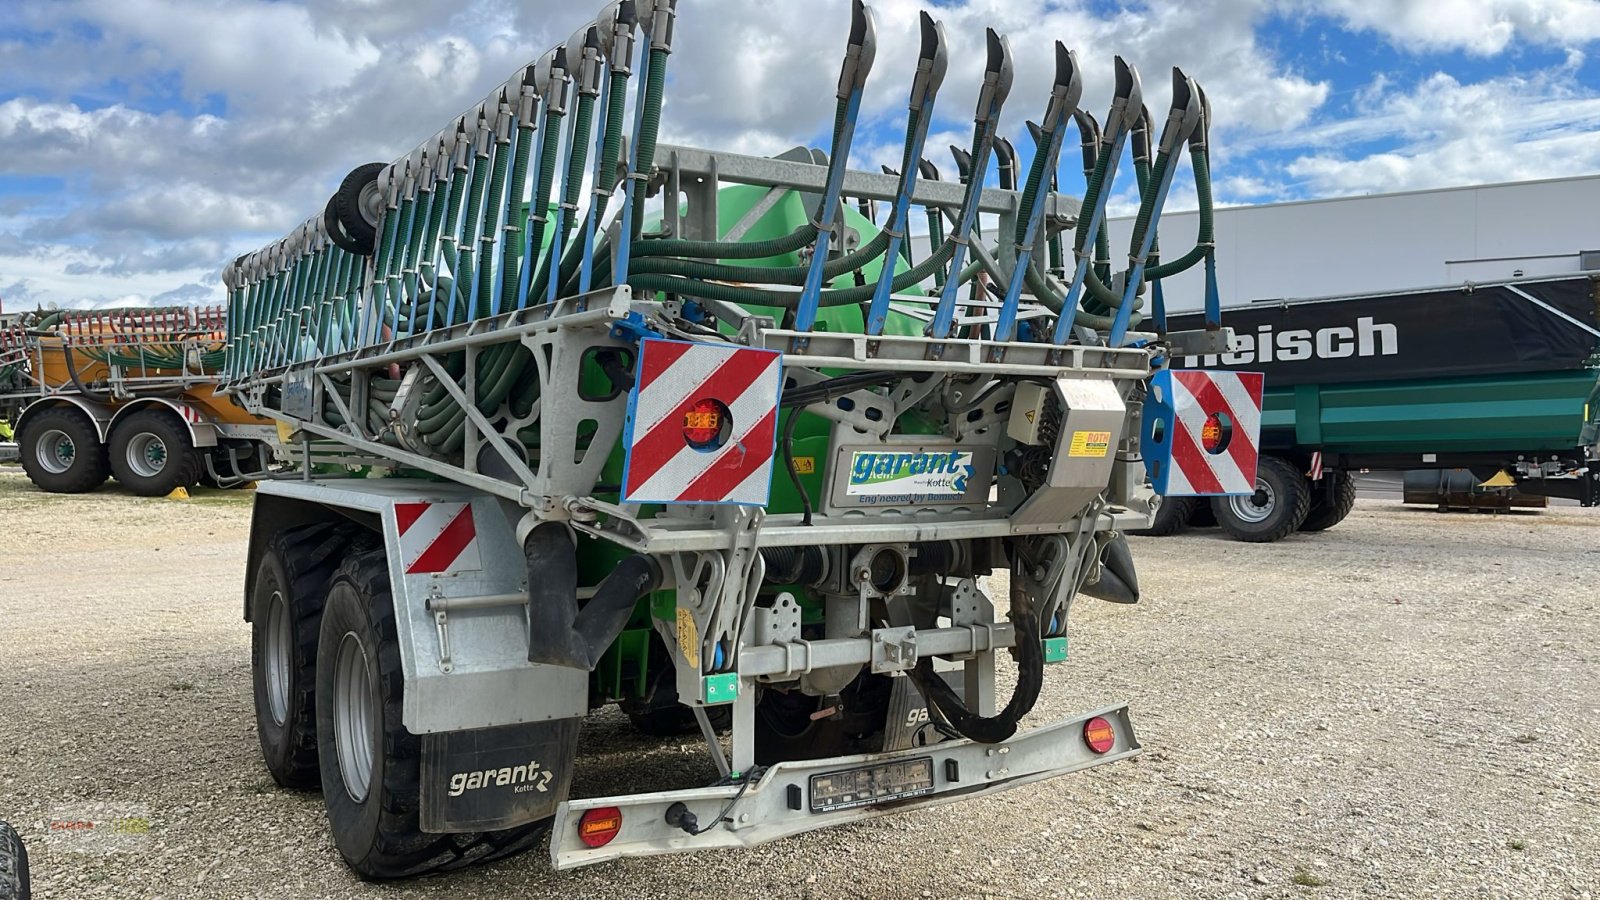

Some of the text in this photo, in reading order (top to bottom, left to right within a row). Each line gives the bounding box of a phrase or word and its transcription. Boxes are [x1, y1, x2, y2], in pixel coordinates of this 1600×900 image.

[1184, 316, 1398, 368] eisch
[1087, 433, 1109, 443] ROTH
[852, 450, 964, 484] garant
[926, 478, 951, 488] Kotte
[859, 492, 912, 504] Engneered
[913, 493, 925, 503] by
[447, 760, 540, 797] garant
[514, 784, 534, 794] Kotte
